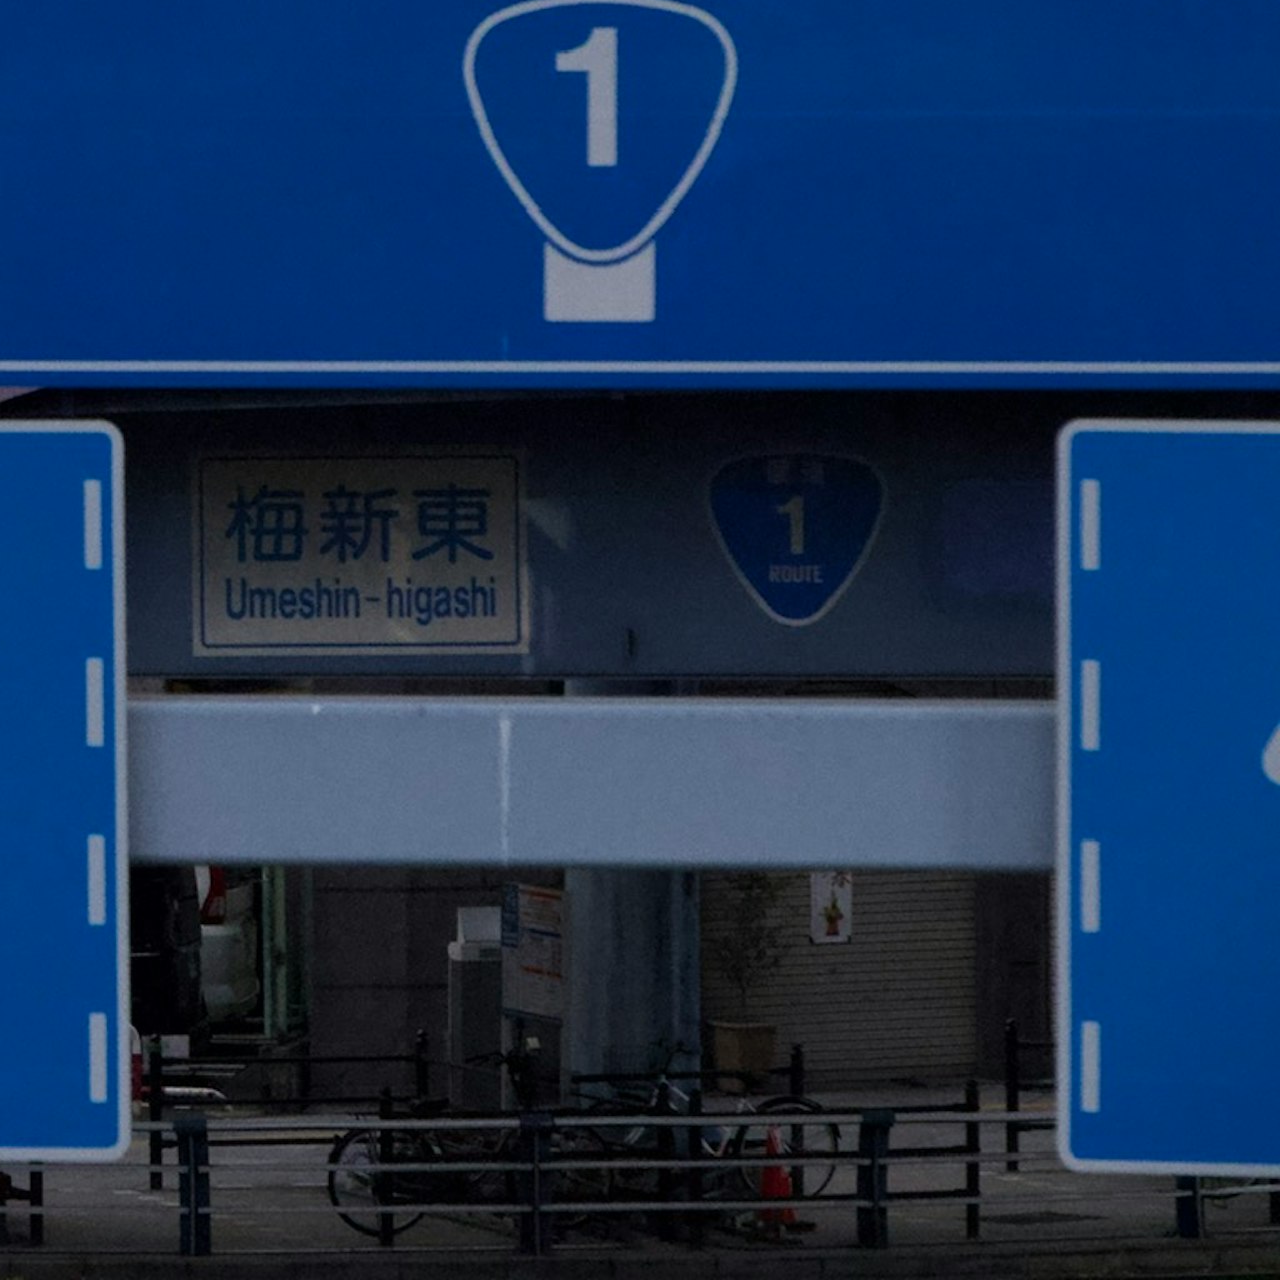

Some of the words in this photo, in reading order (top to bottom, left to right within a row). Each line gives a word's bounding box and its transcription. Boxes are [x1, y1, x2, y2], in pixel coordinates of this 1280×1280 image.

[556, 28, 617, 166] 1
[225, 483, 495, 563] 梅新東
[778, 496, 804, 555] 1
[225, 577, 497, 626] Umeshin-higashi
[768, 564, 824, 584] ROUTE
